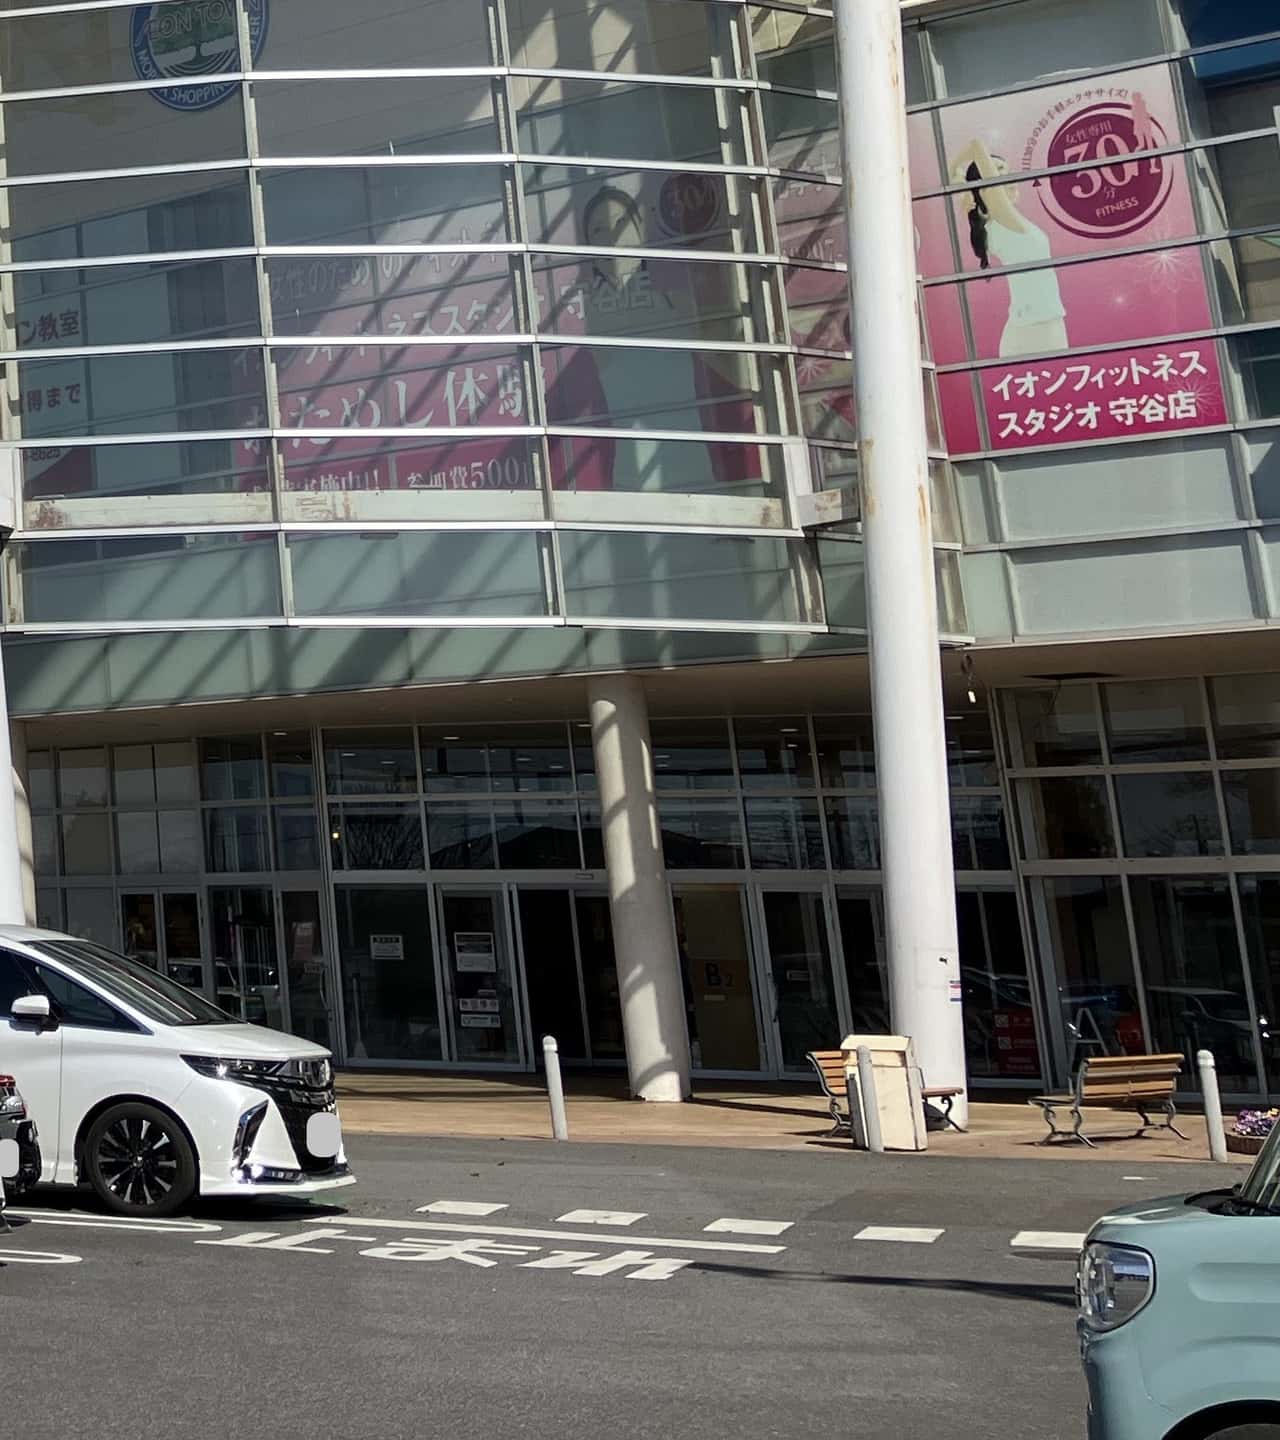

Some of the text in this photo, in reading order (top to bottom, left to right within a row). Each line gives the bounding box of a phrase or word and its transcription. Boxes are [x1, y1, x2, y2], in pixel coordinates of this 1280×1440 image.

[170, 81, 230, 104] SHOPPIN
[1063, 133, 1132, 199] 30
[1095, 196, 1139, 219] FITNESS
[992, 350, 1208, 401] イオンフィットネス
[997, 390, 1198, 439] スタジオ 守谷店
[194, 1227, 695, 1281] 止まれ
